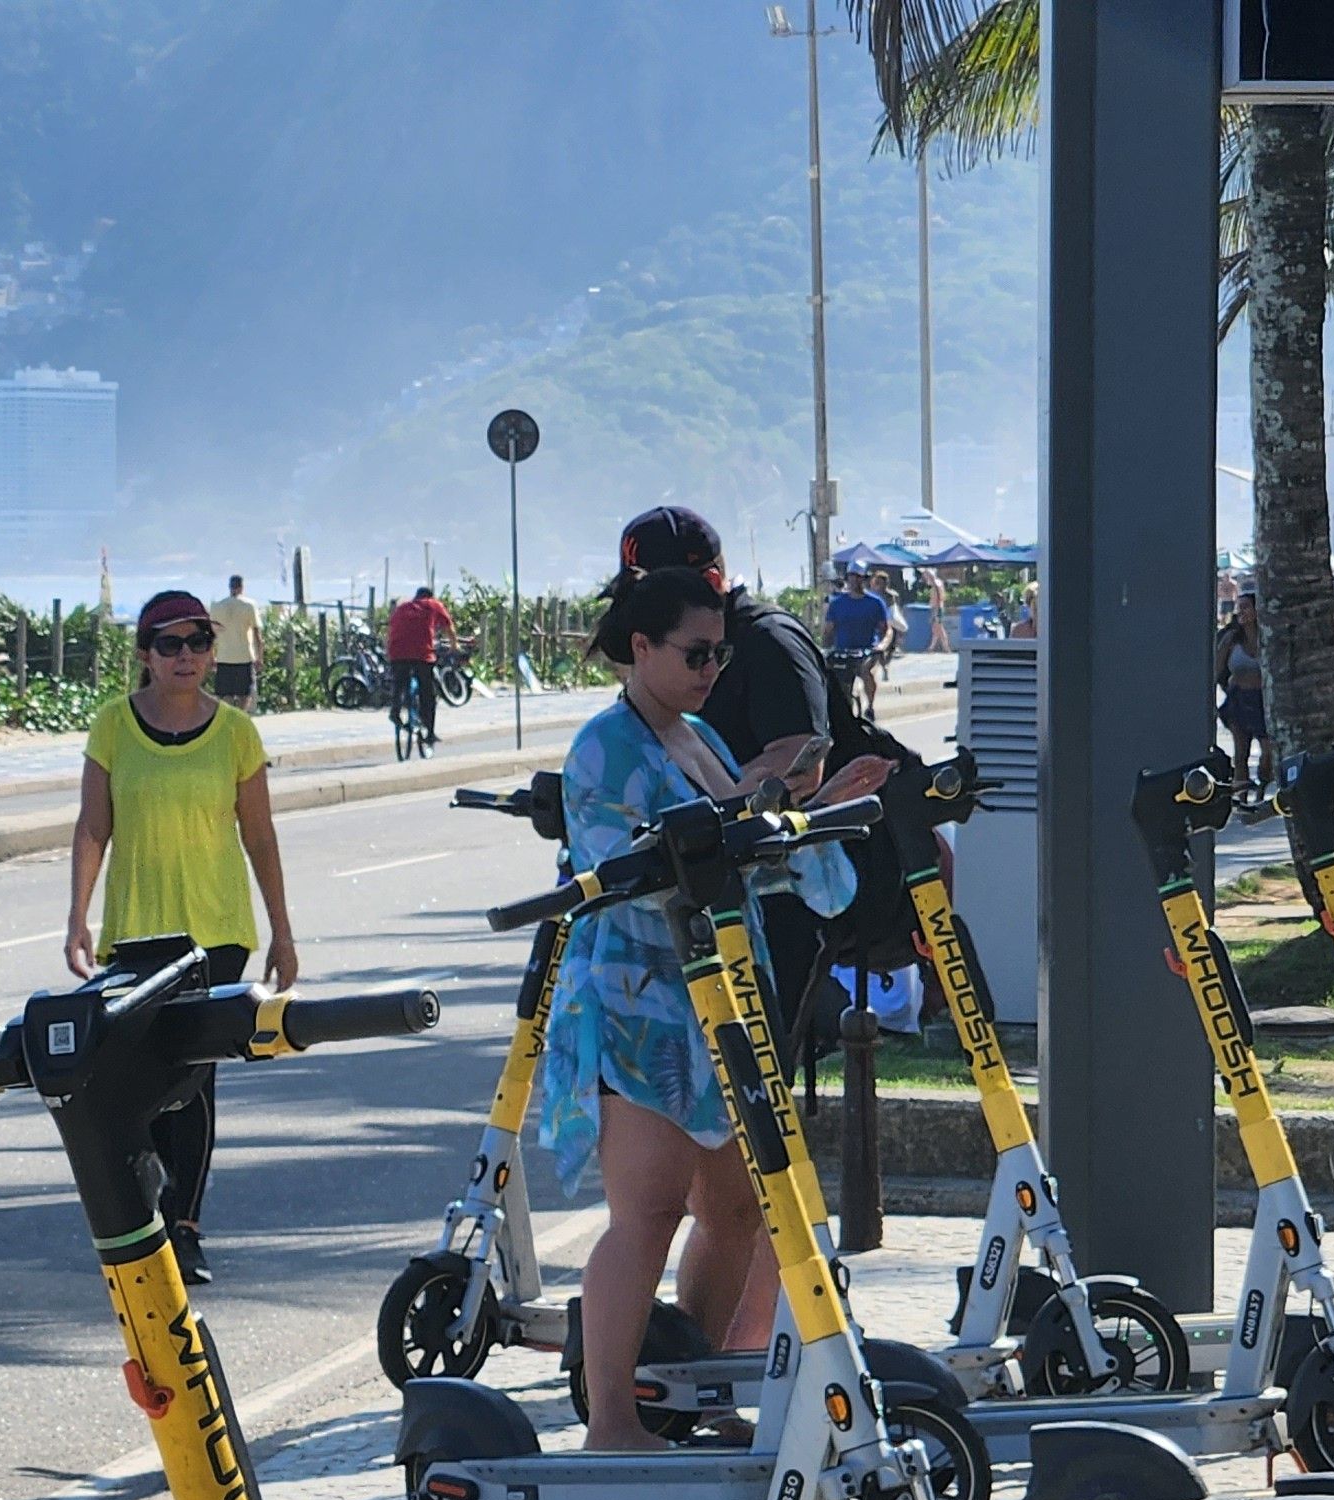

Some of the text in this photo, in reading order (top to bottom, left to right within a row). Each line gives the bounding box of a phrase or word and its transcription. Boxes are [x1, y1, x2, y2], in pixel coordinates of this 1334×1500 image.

[728, 955, 797, 1137] WHOOSH
[928, 907, 1000, 1070] WHOOSH
[1181, 920, 1259, 1098] WHOOSH
